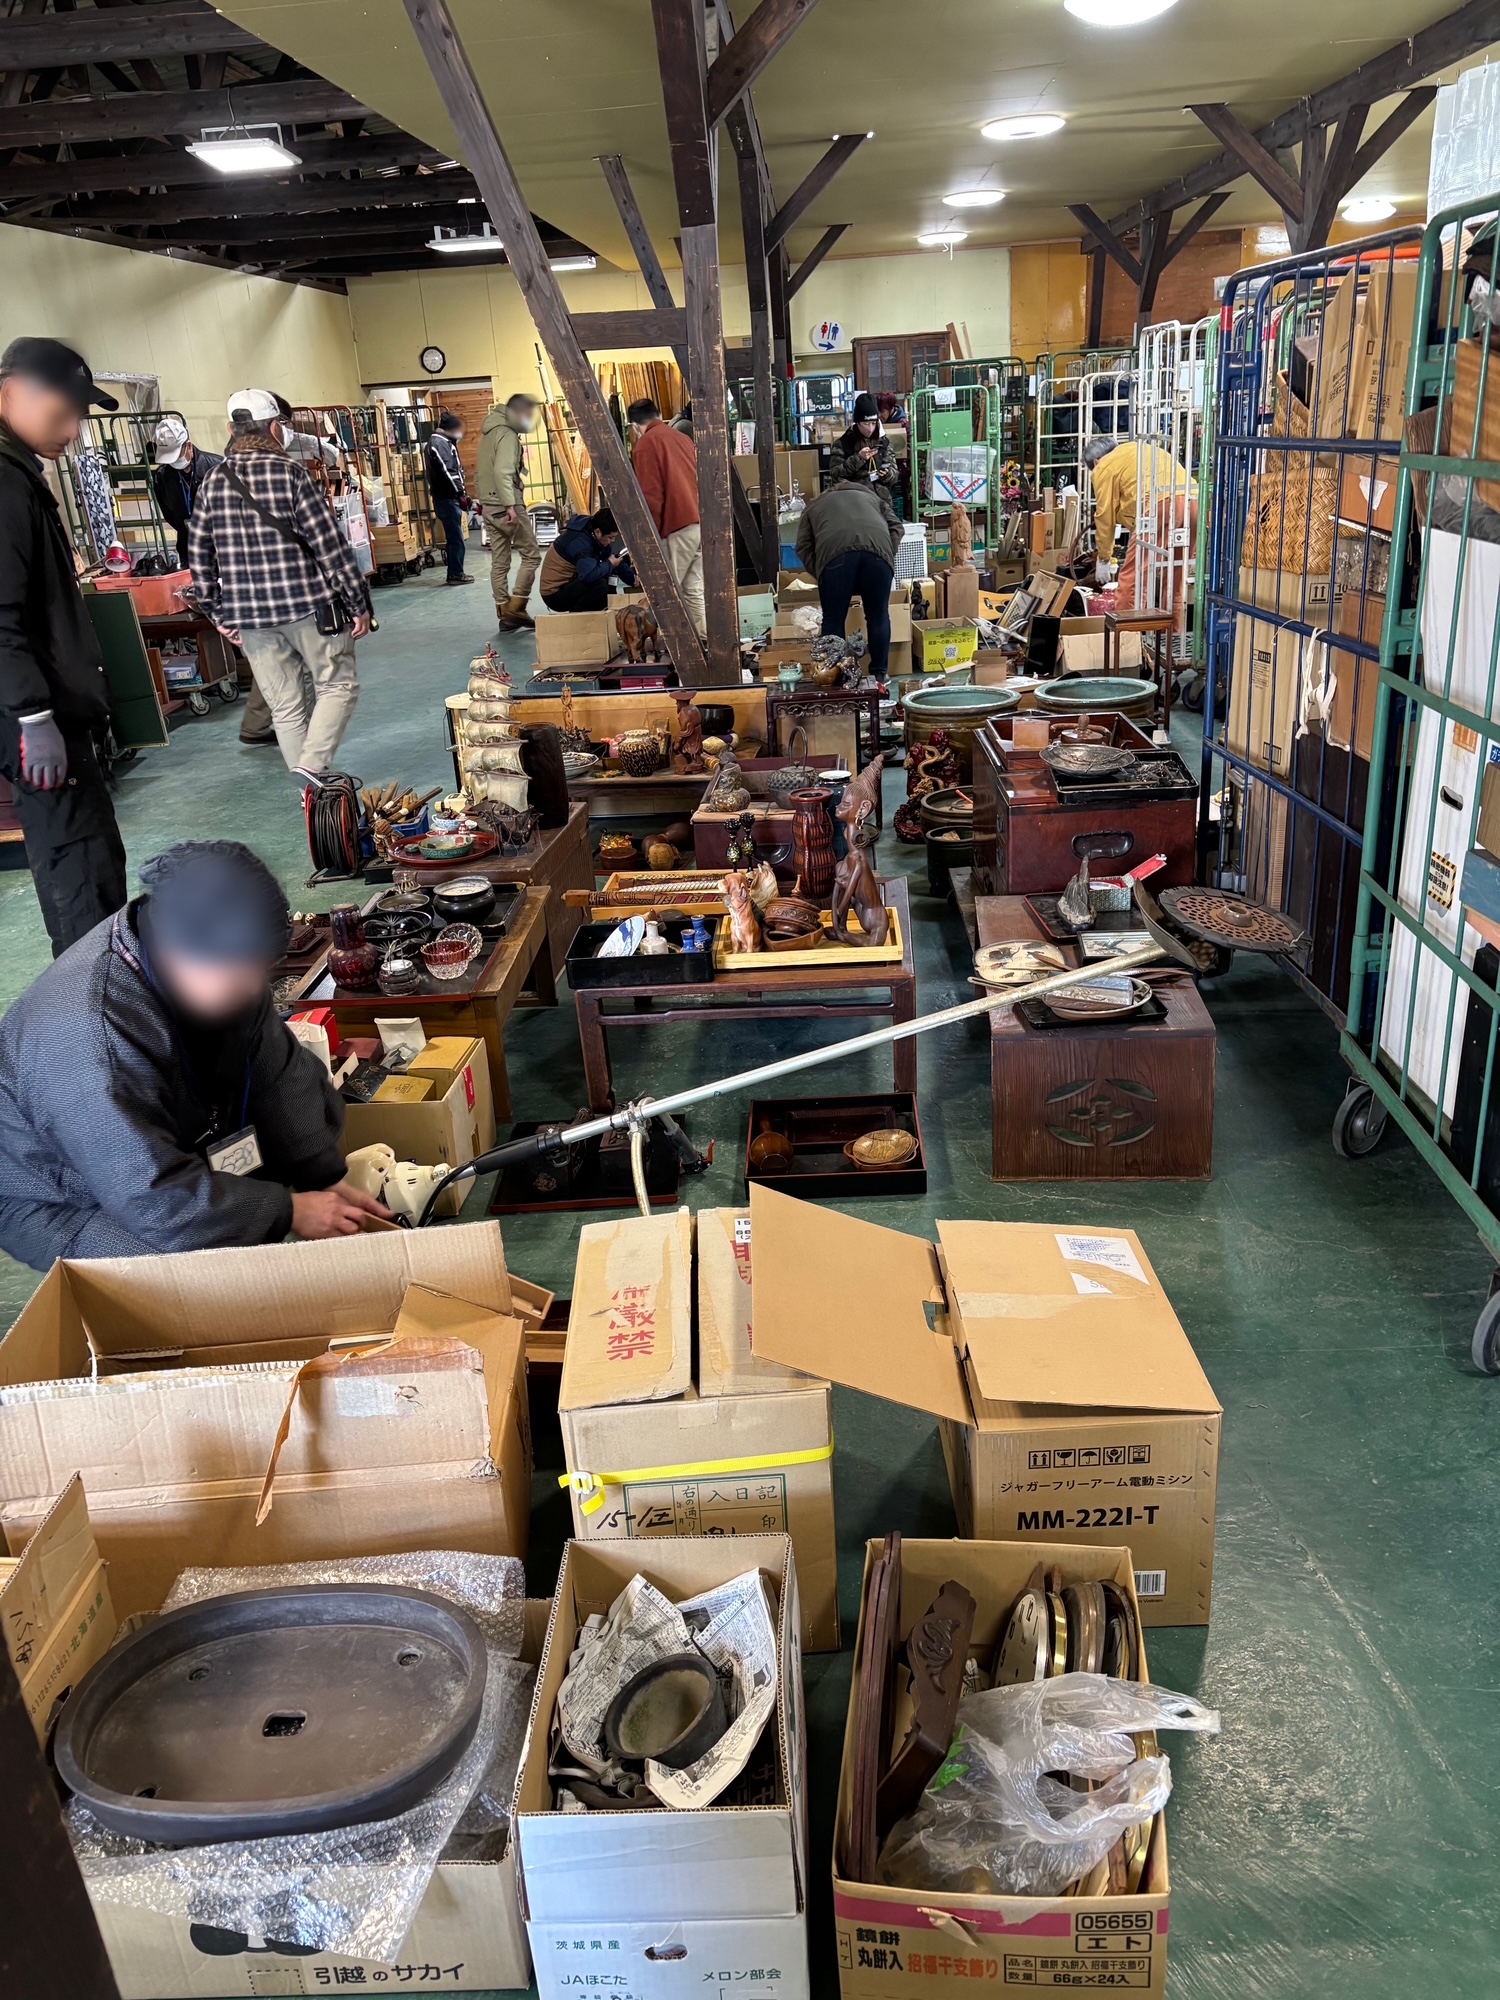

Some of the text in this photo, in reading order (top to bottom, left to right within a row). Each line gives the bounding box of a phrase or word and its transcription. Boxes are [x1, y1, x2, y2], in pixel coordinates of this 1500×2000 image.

[1000, 1474, 1193, 1493] ジャガーフリーアーム電動ミシン
[761, 1514, 776, 1529] 印
[70, 1592, 104, 1653] 北海道産
[1081, 1914, 1147, 1930] 05655
[856, 1927, 900, 1946] 鏡餅
[555, 1940, 621, 1950] 茨城県産
[858, 1947, 999, 1979] 丸餅入 招福干支飾り
[1008, 1959, 1033, 1968] 品名
[313, 1963, 464, 1985] 引越のサカイ
[561, 1974, 628, 1986] JAほこた
[702, 1968, 782, 1982] メロン部会
[1008, 1971, 1033, 1981] 数量
